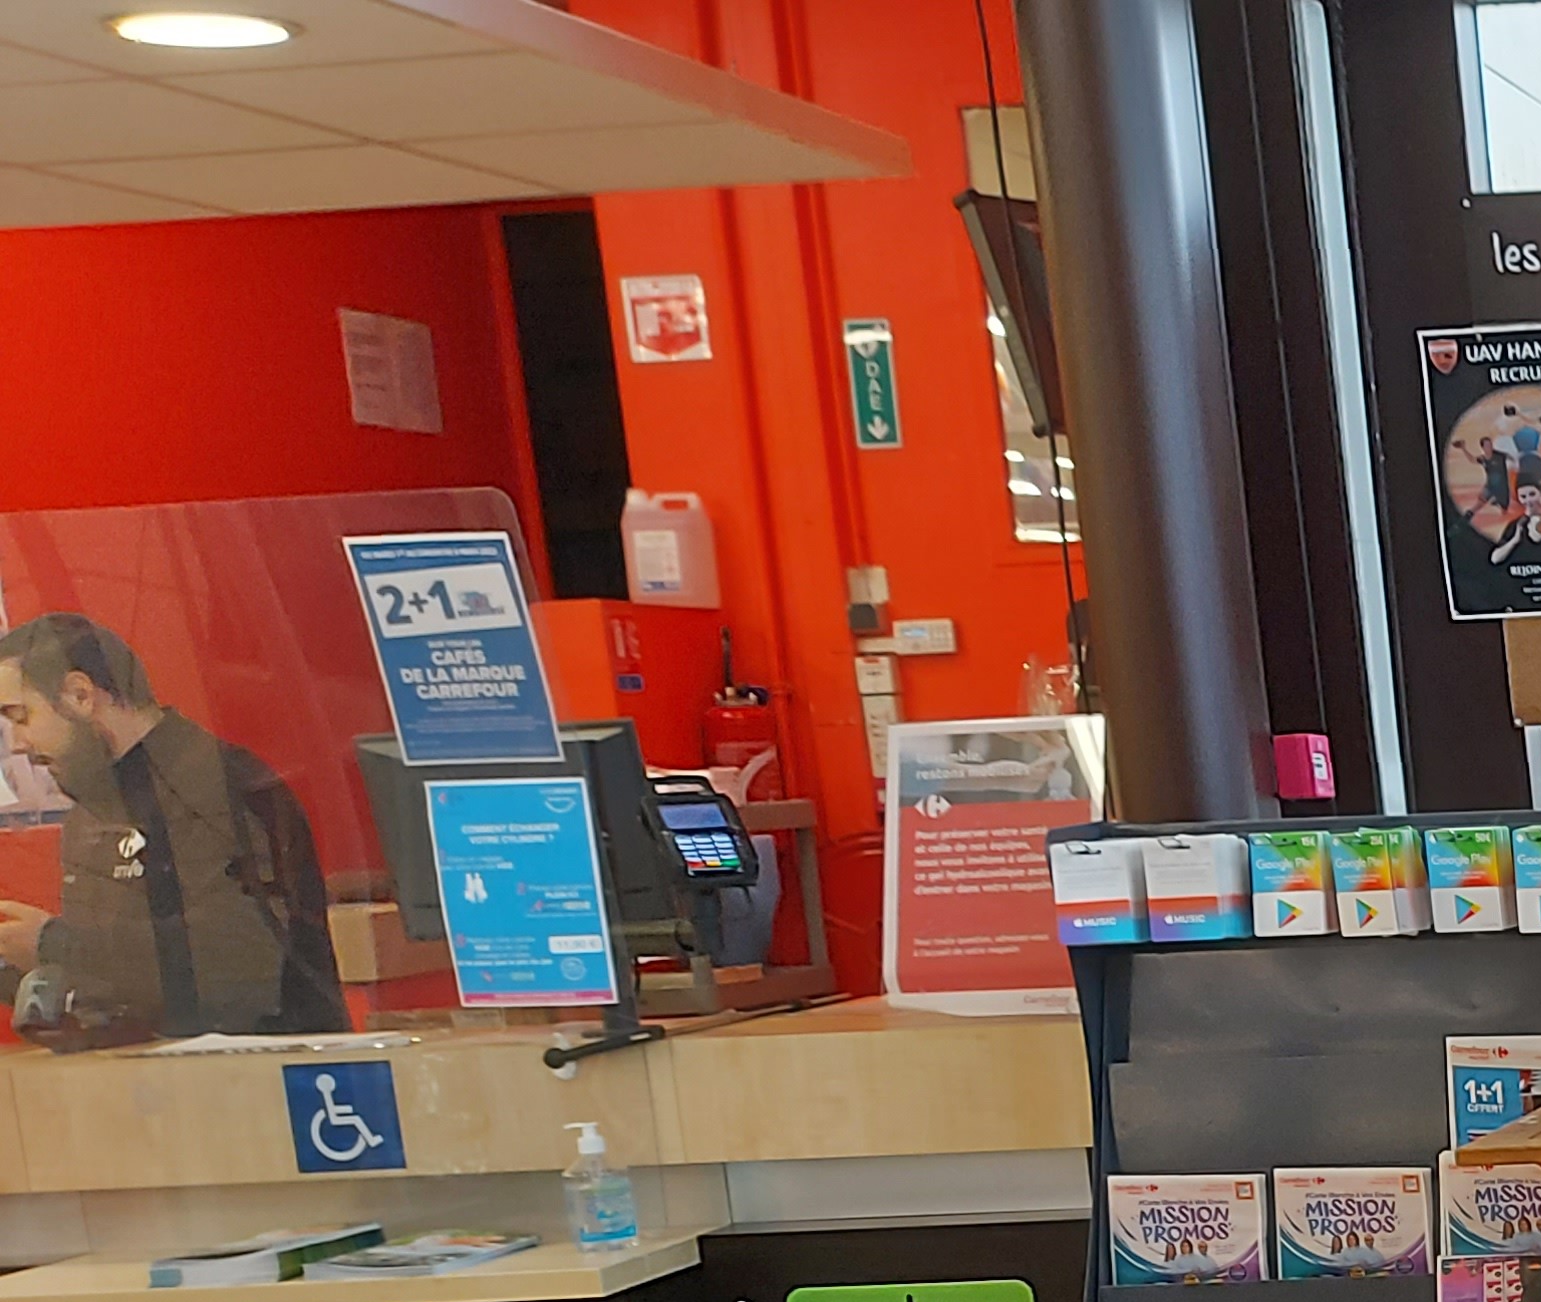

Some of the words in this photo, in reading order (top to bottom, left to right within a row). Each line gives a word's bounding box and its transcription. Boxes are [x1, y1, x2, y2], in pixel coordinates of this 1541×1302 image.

[1491, 232, 1541, 275] les
[1465, 343, 1501, 362] UAV
[400, 668, 424, 684] DE
[426, 667, 450, 683] LA
[453, 665, 527, 682] MARQUE
[416, 682, 519, 700] CARREFOUR
[1431, 855, 1469, 867] Google
[1083, 917, 1117, 926] MUSIC
[1173, 914, 1206, 924] MUSIC
[1464, 1079, 1504, 1105] 1+1
[1467, 1103, 1504, 1113] OFFERT
[1139, 1206, 1230, 1226] MISSION
[1306, 1199, 1395, 1218] MISSION
[1141, 1224, 1230, 1244] PROMOS
[1308, 1216, 1396, 1237] PROMOS
